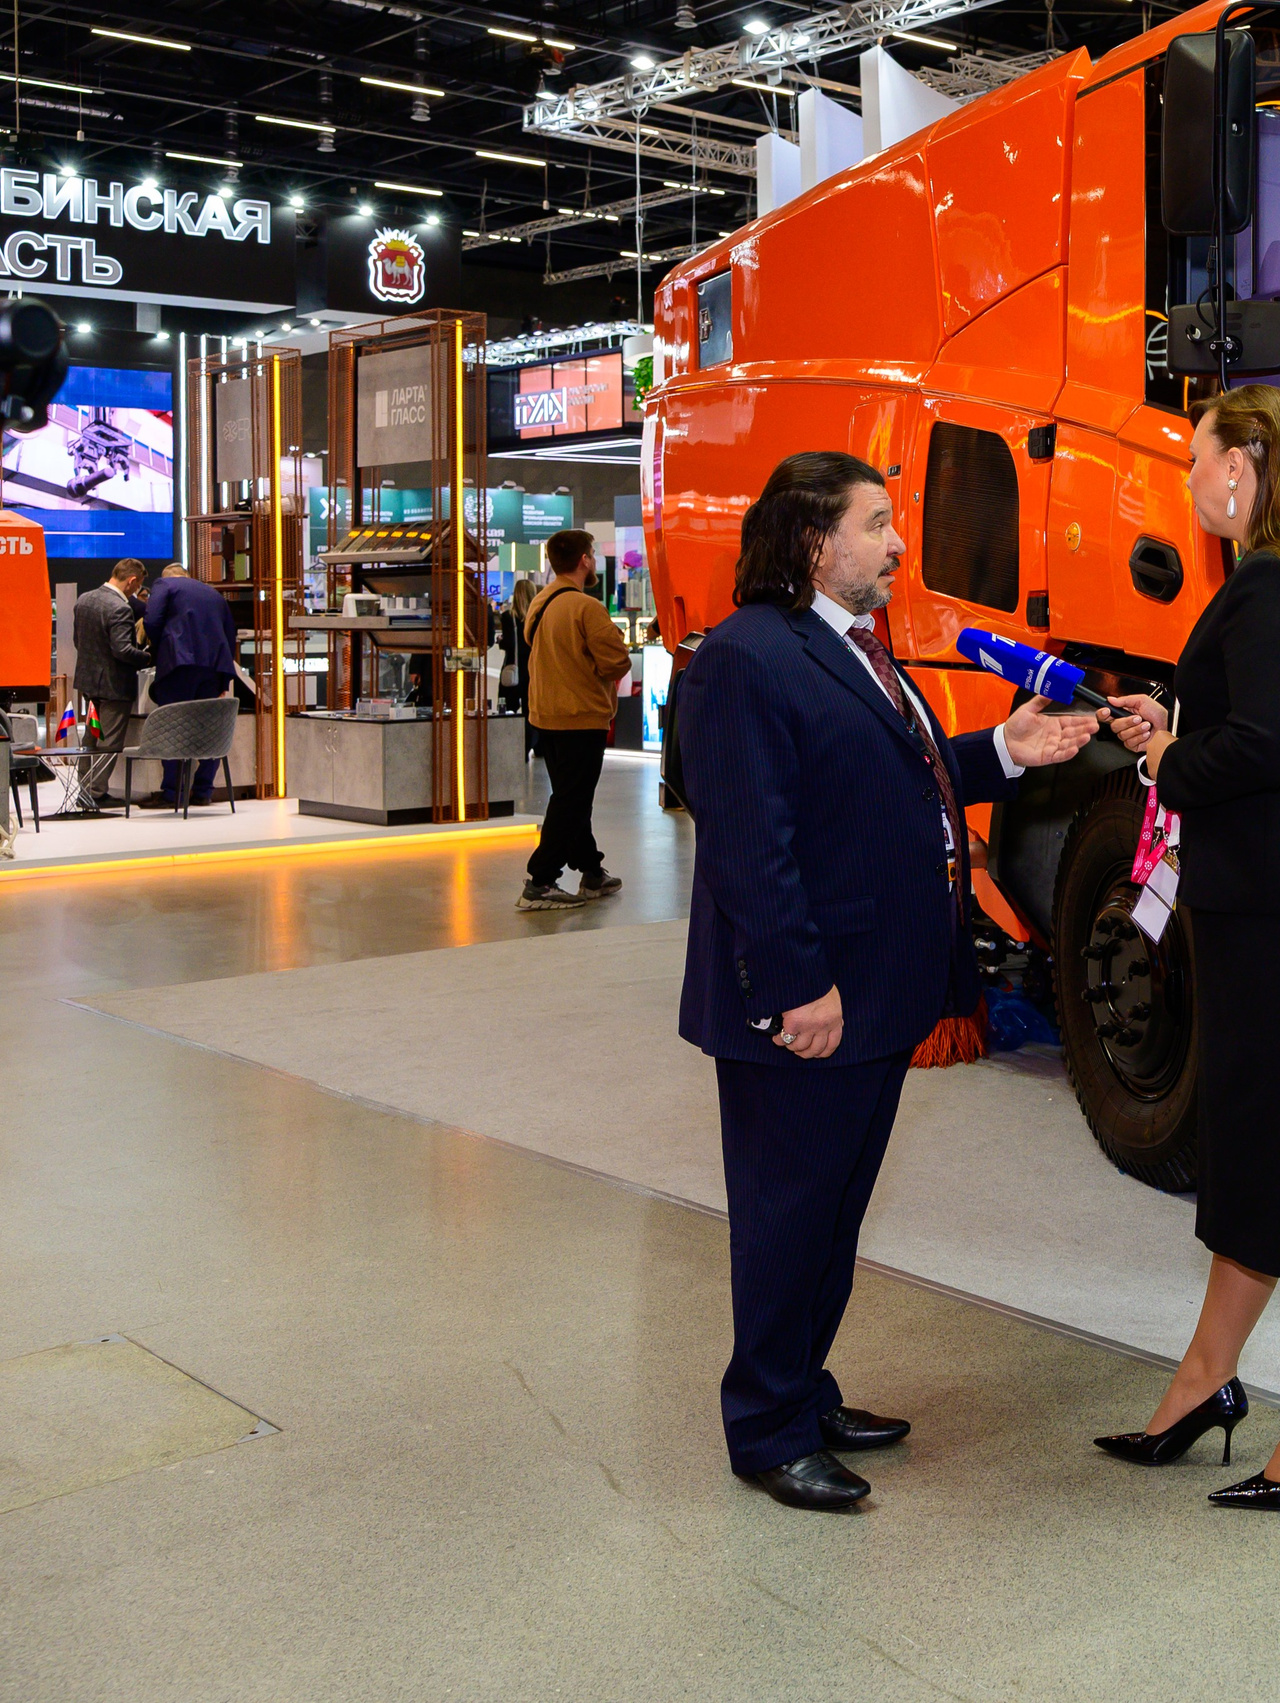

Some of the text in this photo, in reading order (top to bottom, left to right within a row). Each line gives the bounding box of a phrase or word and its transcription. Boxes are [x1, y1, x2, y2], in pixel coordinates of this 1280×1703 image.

[0, 167, 271, 244] БИНСКАЯ
[0, 230, 123, 285] СТЬ
[391, 405, 426, 426] ГЛАСС
